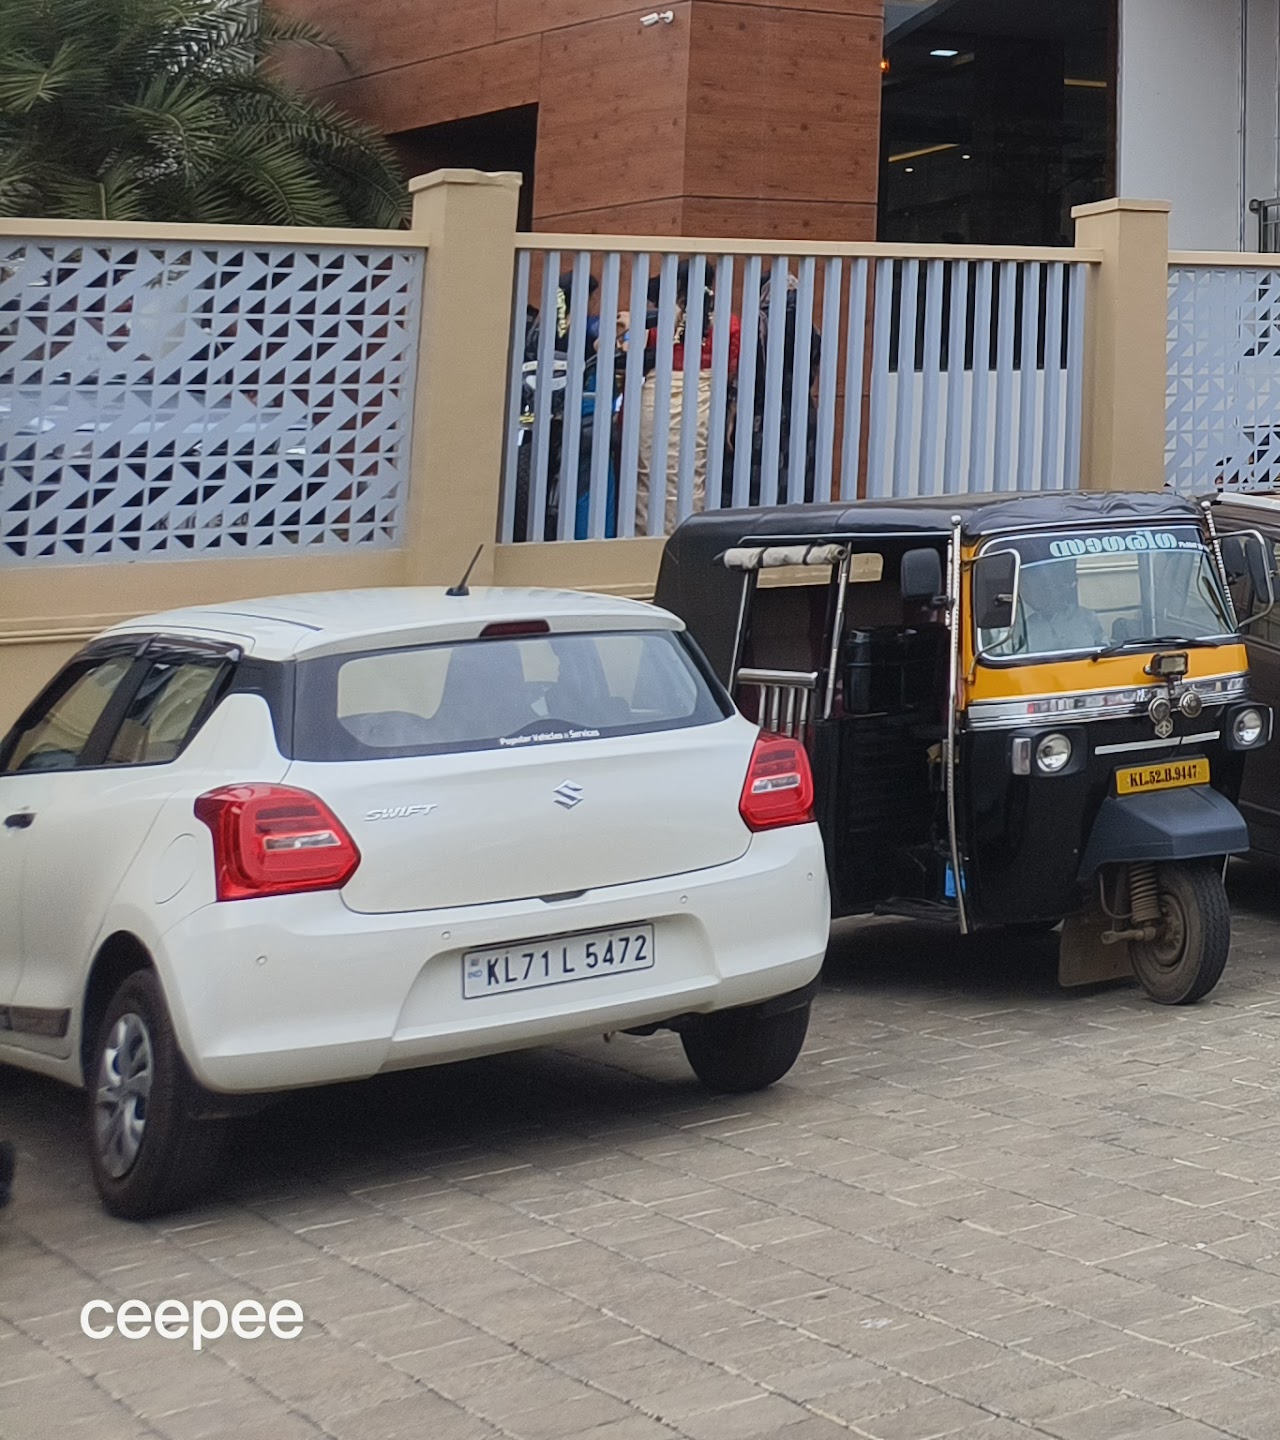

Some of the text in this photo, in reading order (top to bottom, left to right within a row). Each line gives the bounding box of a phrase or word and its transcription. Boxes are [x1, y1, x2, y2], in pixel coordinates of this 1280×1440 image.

[569, 729, 601, 739] Services
[363, 803, 438, 823] SWIFT
[585, 934, 648, 969] 5472
